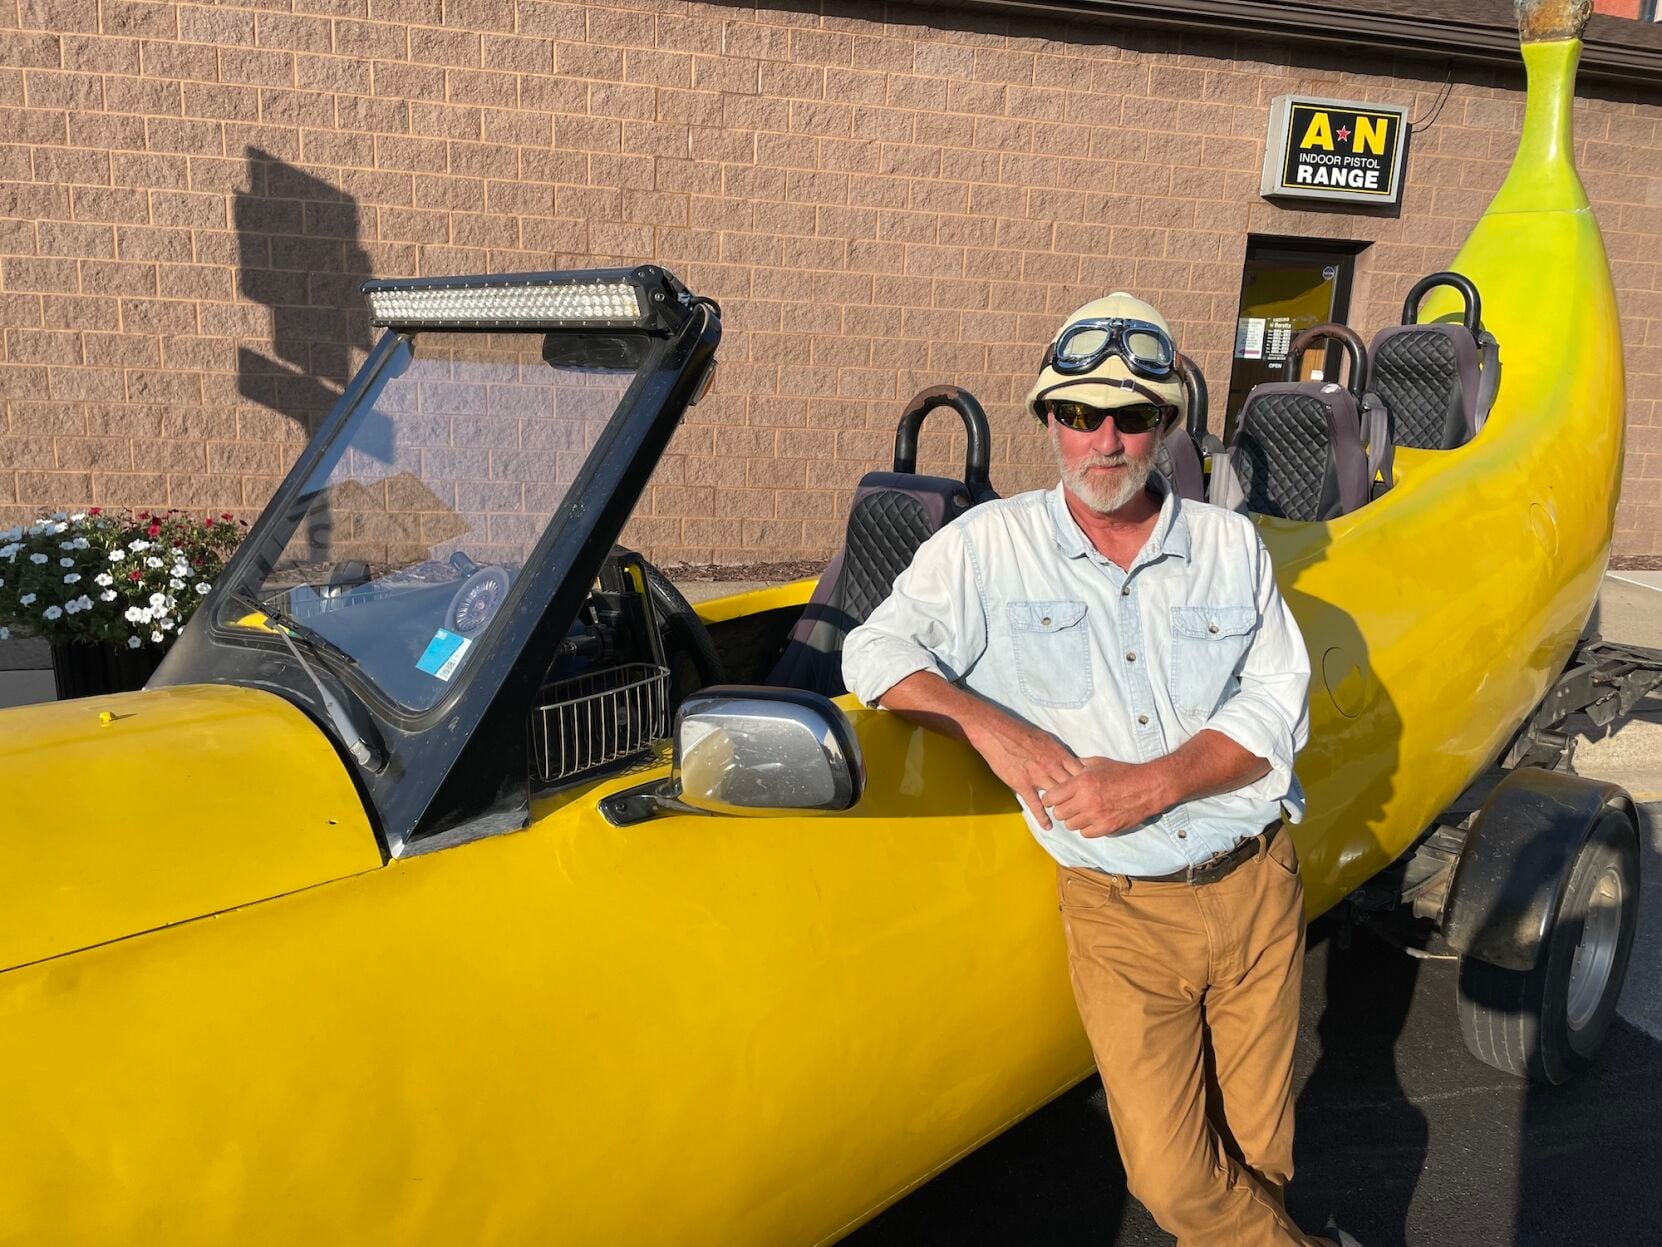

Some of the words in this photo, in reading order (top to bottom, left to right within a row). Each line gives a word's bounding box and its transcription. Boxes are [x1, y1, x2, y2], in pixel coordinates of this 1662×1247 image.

[1299, 153, 1341, 165] INDOOR
[1344, 157, 1380, 168] PISTOL
[1297, 165, 1379, 188] RANGE
